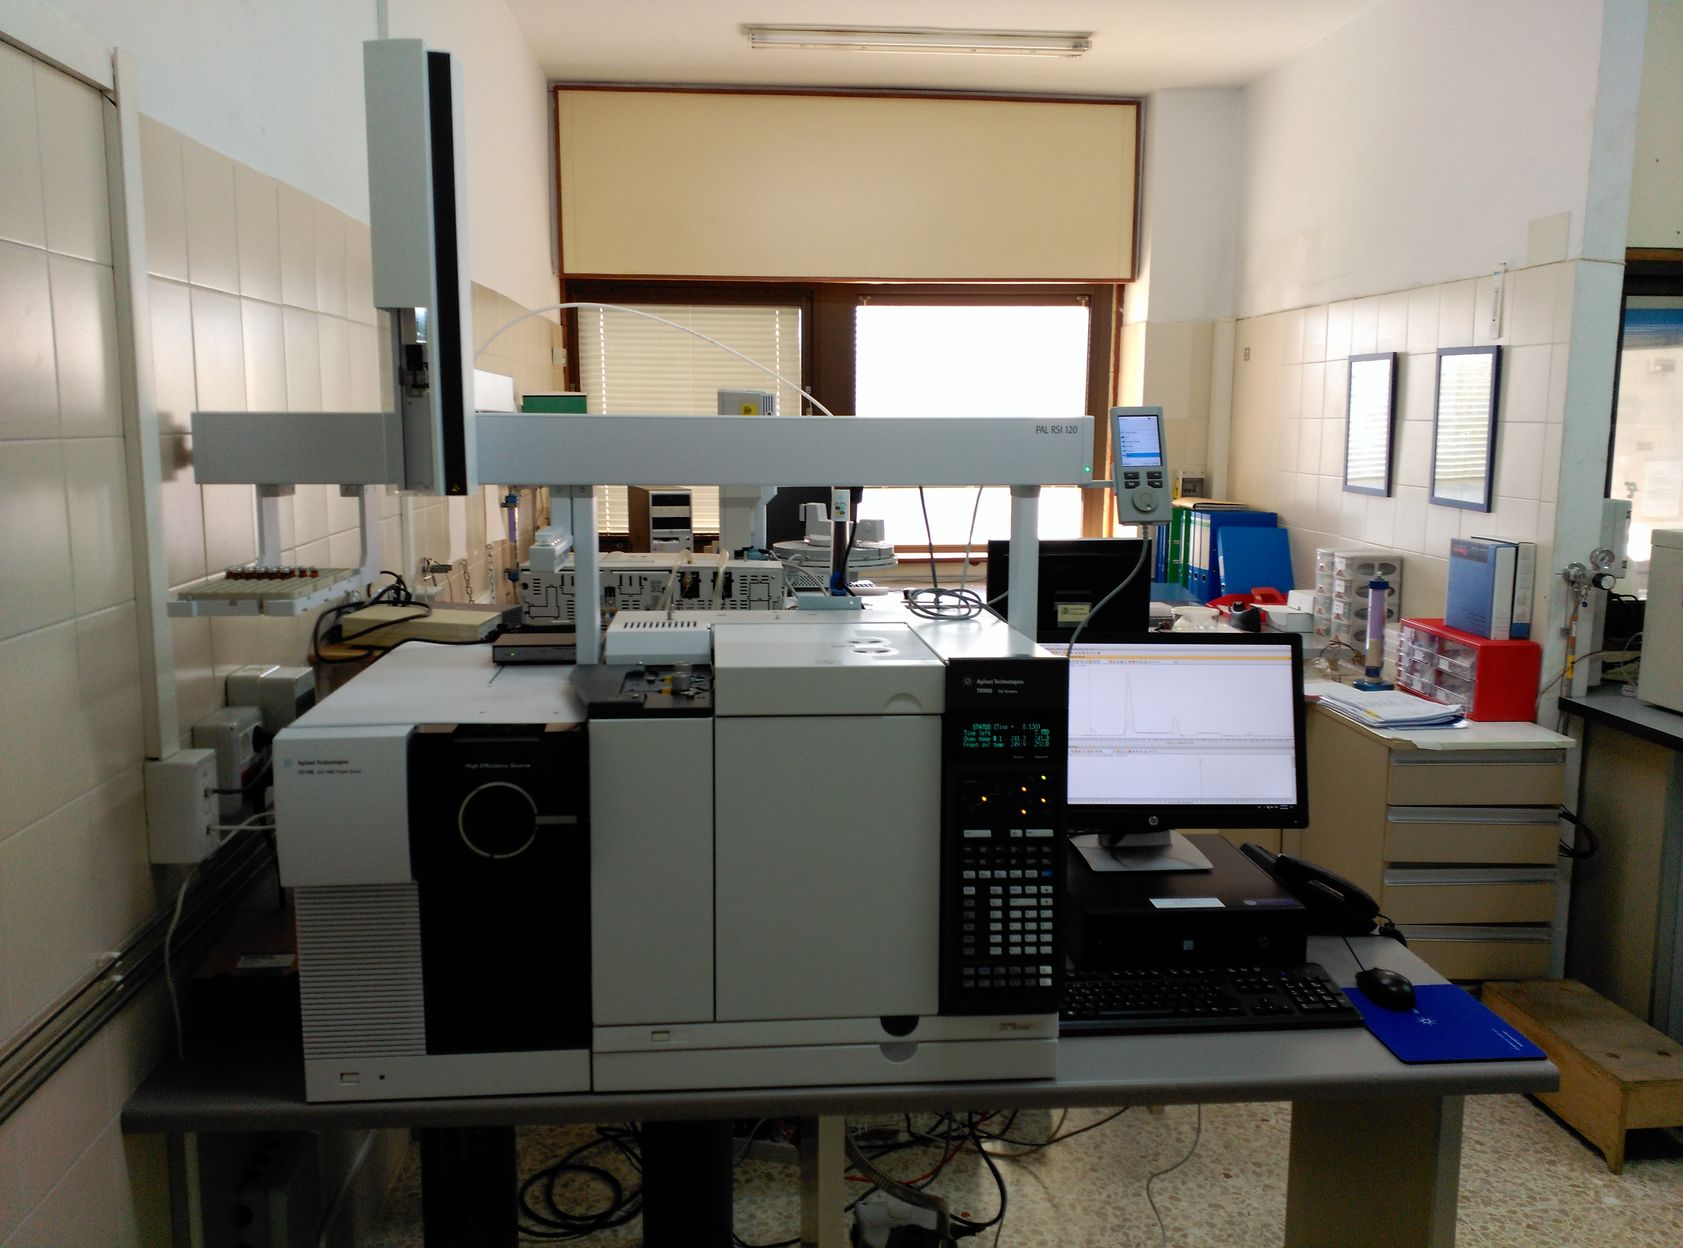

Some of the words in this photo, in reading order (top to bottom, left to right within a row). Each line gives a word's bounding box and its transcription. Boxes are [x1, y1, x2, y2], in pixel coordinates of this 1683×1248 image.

[1035, 425, 1049, 434] PAL
[1051, 425, 1063, 434] RSI
[1065, 425, 1078, 434] 120
